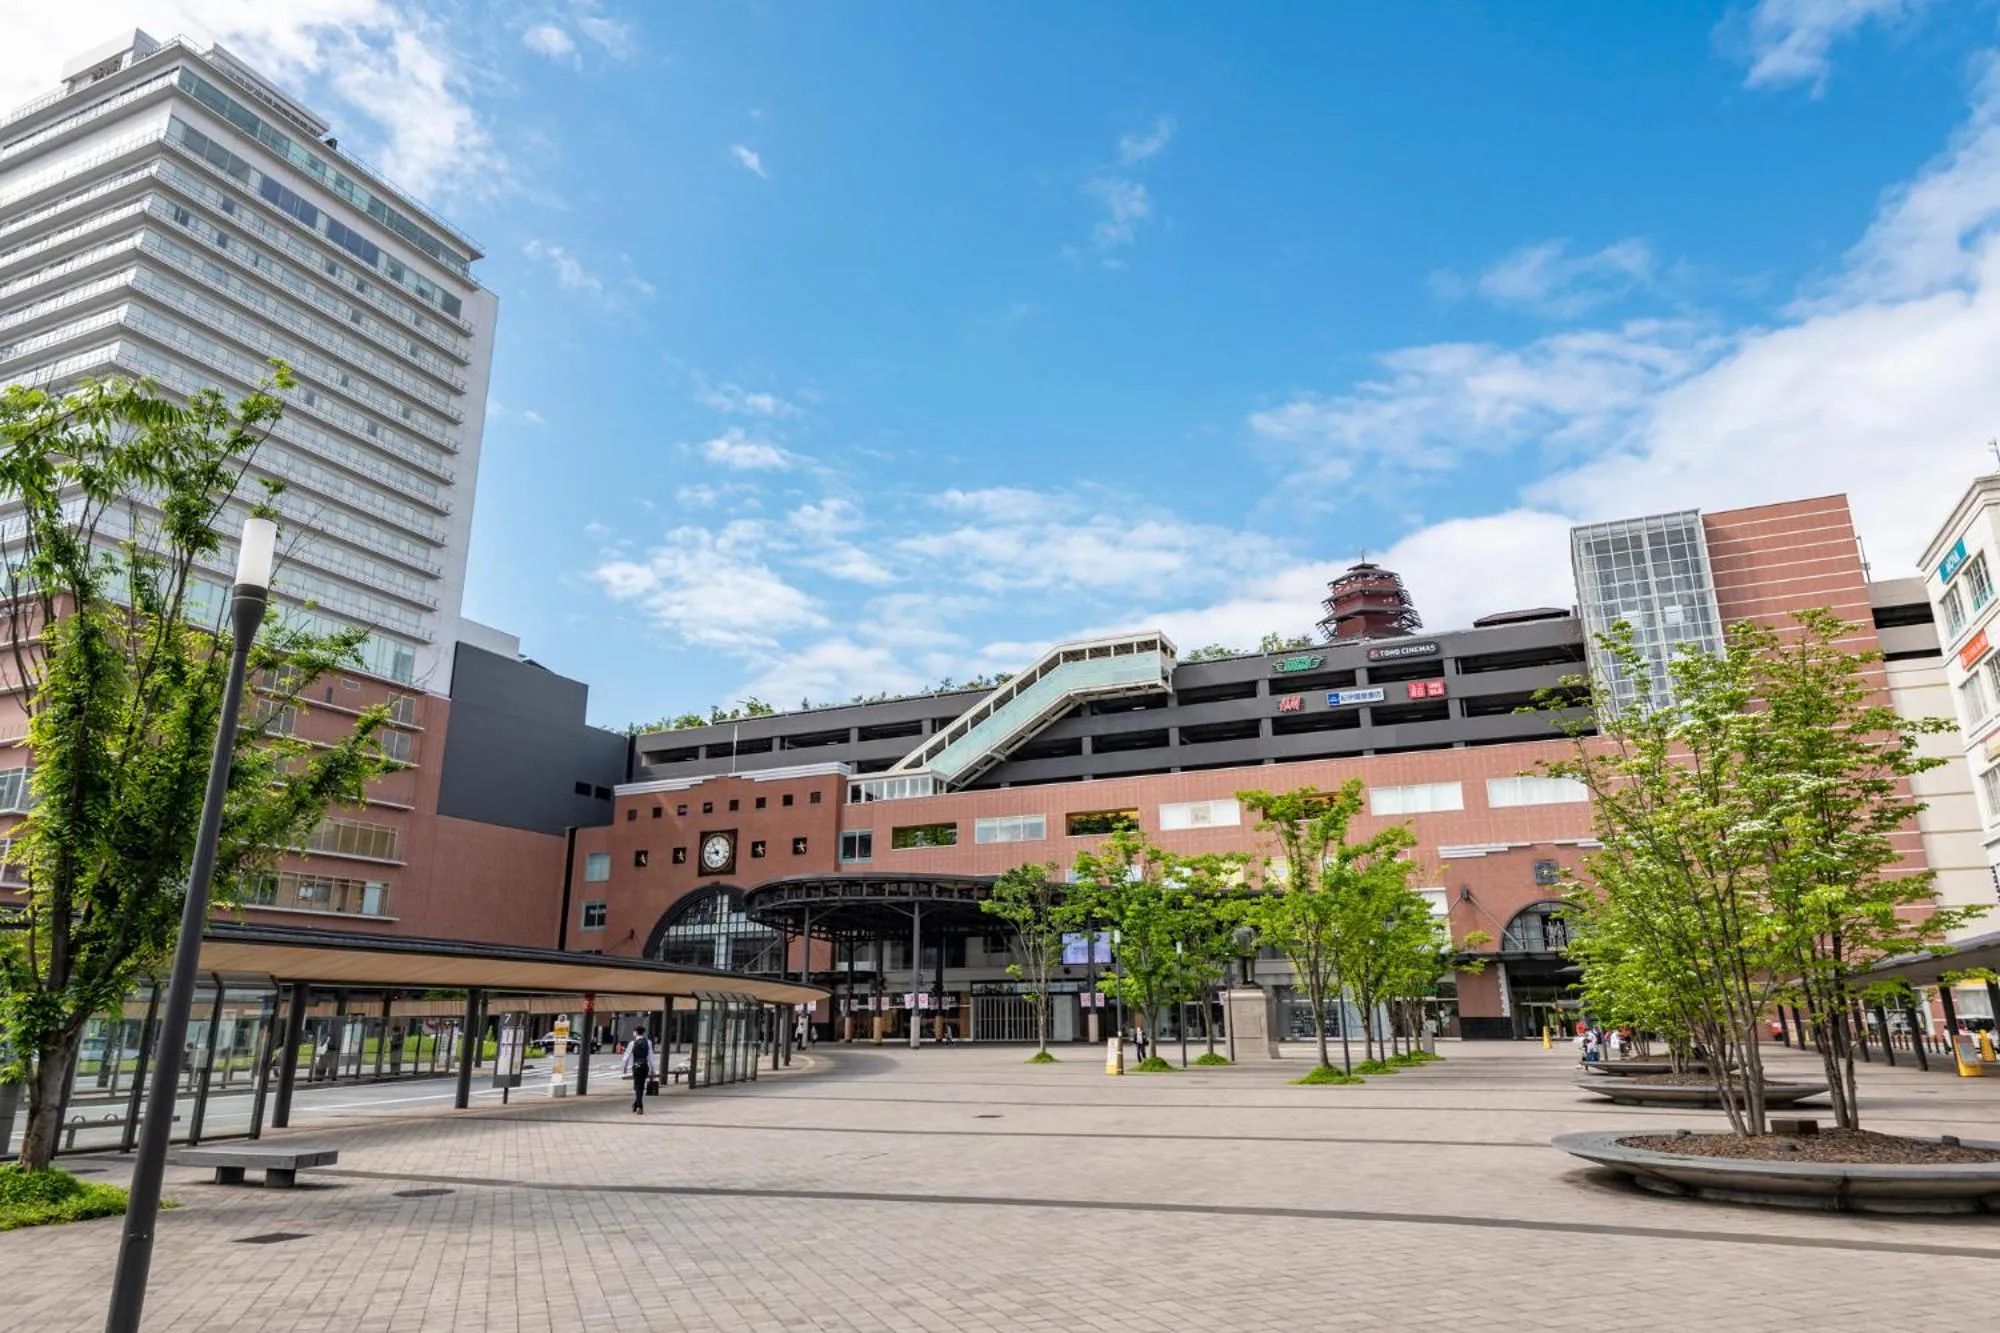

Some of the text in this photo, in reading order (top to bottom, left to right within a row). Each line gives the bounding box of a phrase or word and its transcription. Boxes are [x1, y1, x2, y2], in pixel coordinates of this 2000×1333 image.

[1380, 645, 1436, 657] TOHO CINEMAS
[505, 1014, 512, 1024] 7
